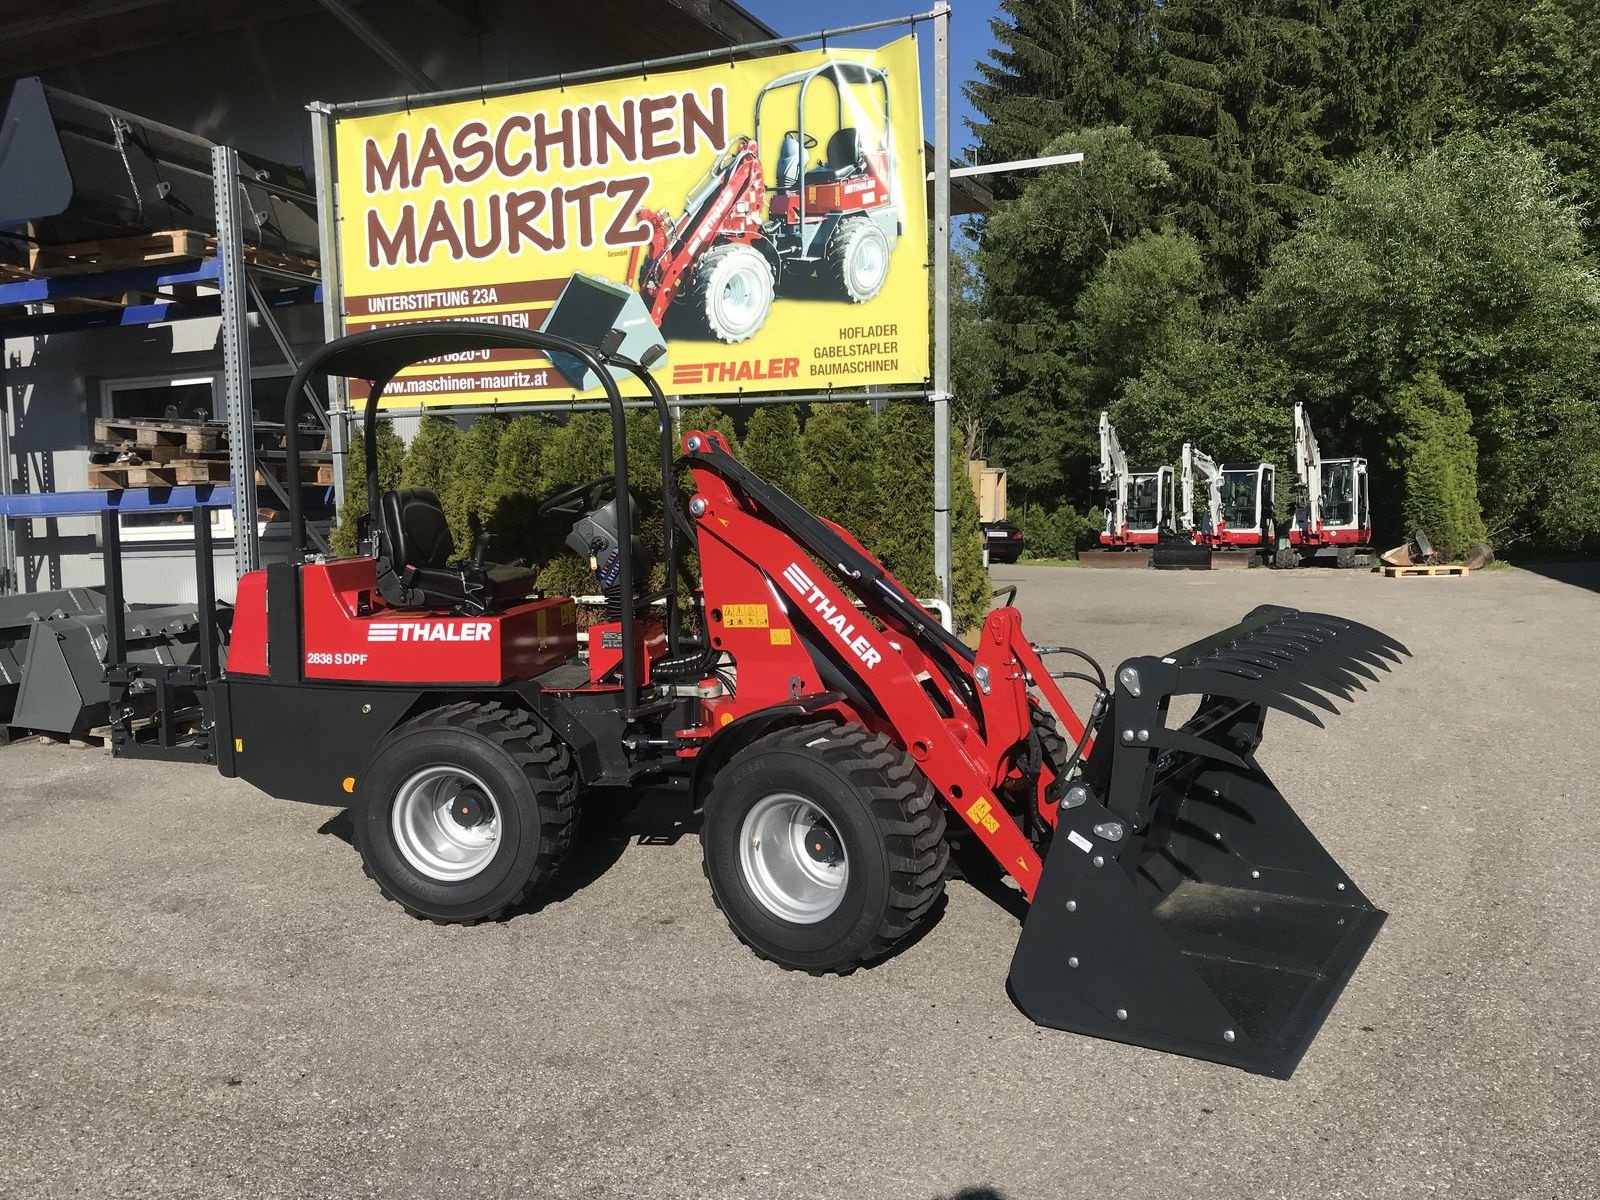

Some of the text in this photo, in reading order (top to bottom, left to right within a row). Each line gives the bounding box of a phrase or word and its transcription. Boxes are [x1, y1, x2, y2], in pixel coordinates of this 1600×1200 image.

[366, 87, 725, 193] MASCHINEN
[367, 177, 651, 267] MAURITZ
[368, 287, 498, 313] UNTERSTIFTUNG 23A
[839, 323, 898, 340] HOFLADER
[813, 341, 898, 359] GABELSTAPLER
[701, 357, 800, 382] THALER
[809, 358, 899, 376] BAUMASCHINEN
[372, 371, 548, 394] ww.maschinen-mauritz.at
[399, 623, 492, 642] THALER
[807, 585, 882, 670] THALER
[307, 653, 368, 665] 2838 S DPF
